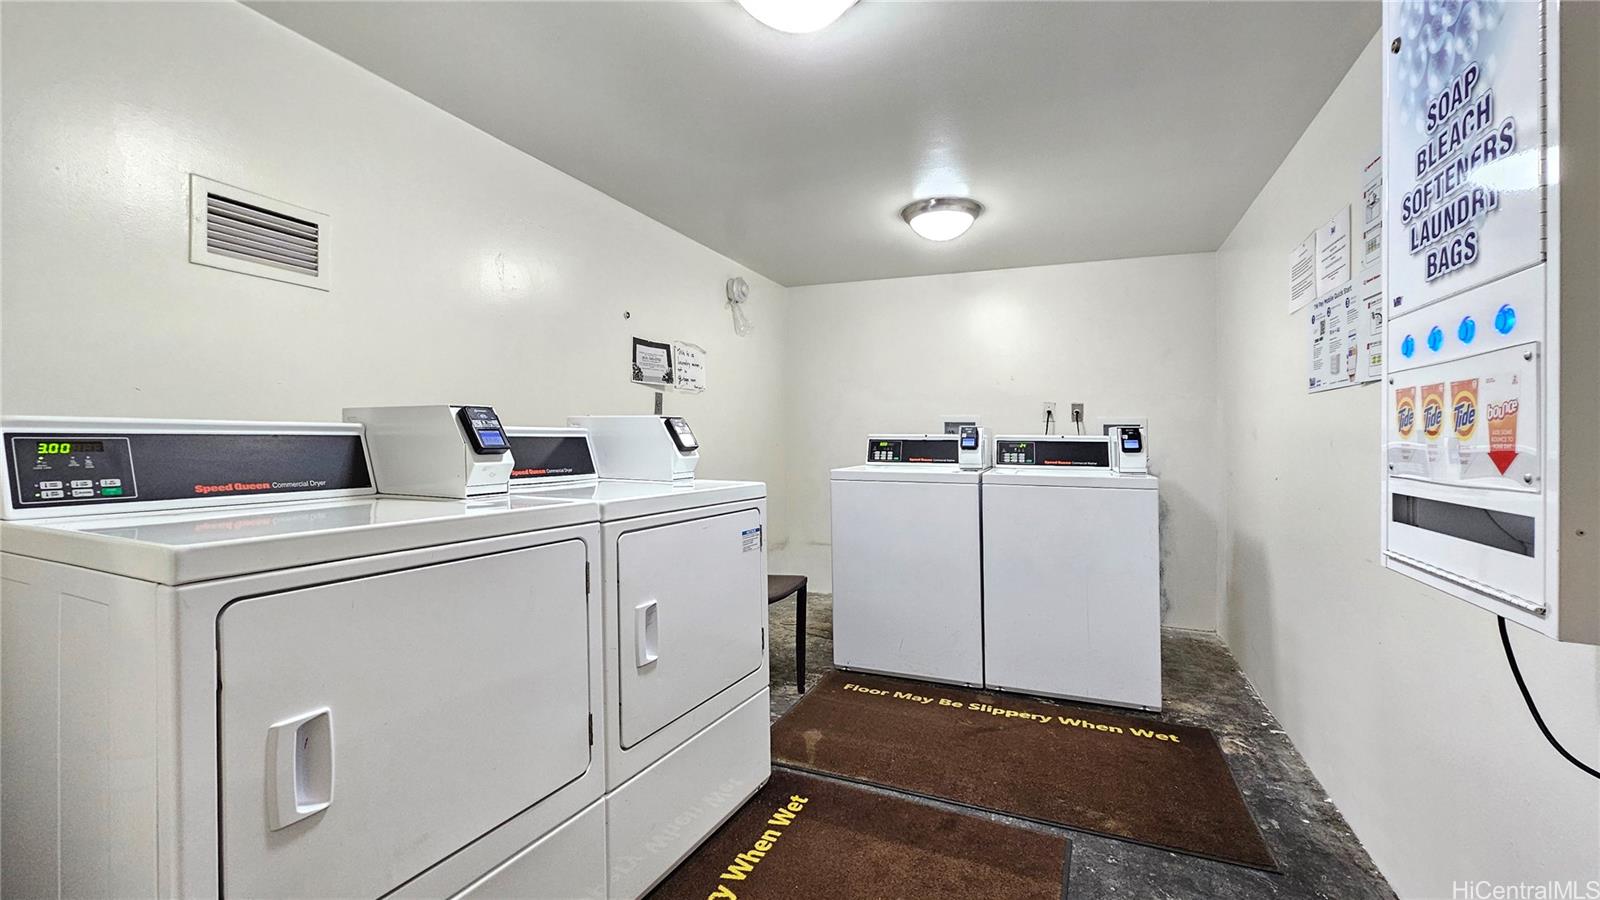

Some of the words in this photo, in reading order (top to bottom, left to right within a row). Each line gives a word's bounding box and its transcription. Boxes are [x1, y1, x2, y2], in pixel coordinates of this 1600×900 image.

[1427, 63, 1480, 131] SOAP
[1416, 91, 1492, 177] BLEACH
[1401, 119, 1515, 222] SOFTENERS
[1426, 232, 1477, 280] BAGS
[1398, 408, 1415, 433] Tide
[1423, 403, 1442, 433] Tide
[1454, 402, 1476, 433] Tide
[1487, 398, 1519, 422] bounce
[38, 442, 71, 454] 3.00
[194, 482, 234, 494] Speed
[233, 481, 272, 492] Queen
[271, 481, 309, 489] Commercial
[309, 479, 327, 489] Dryer
[843, 682, 890, 698] Floor
[893, 689, 935, 708] May
[938, 697, 964, 709] Be
[968, 700, 1053, 725] Slippery
[1057, 714, 1125, 735] When
[1129, 727, 1182, 744] Wet
[720, 829, 782, 881] When
[767, 794, 809, 827] Wet
